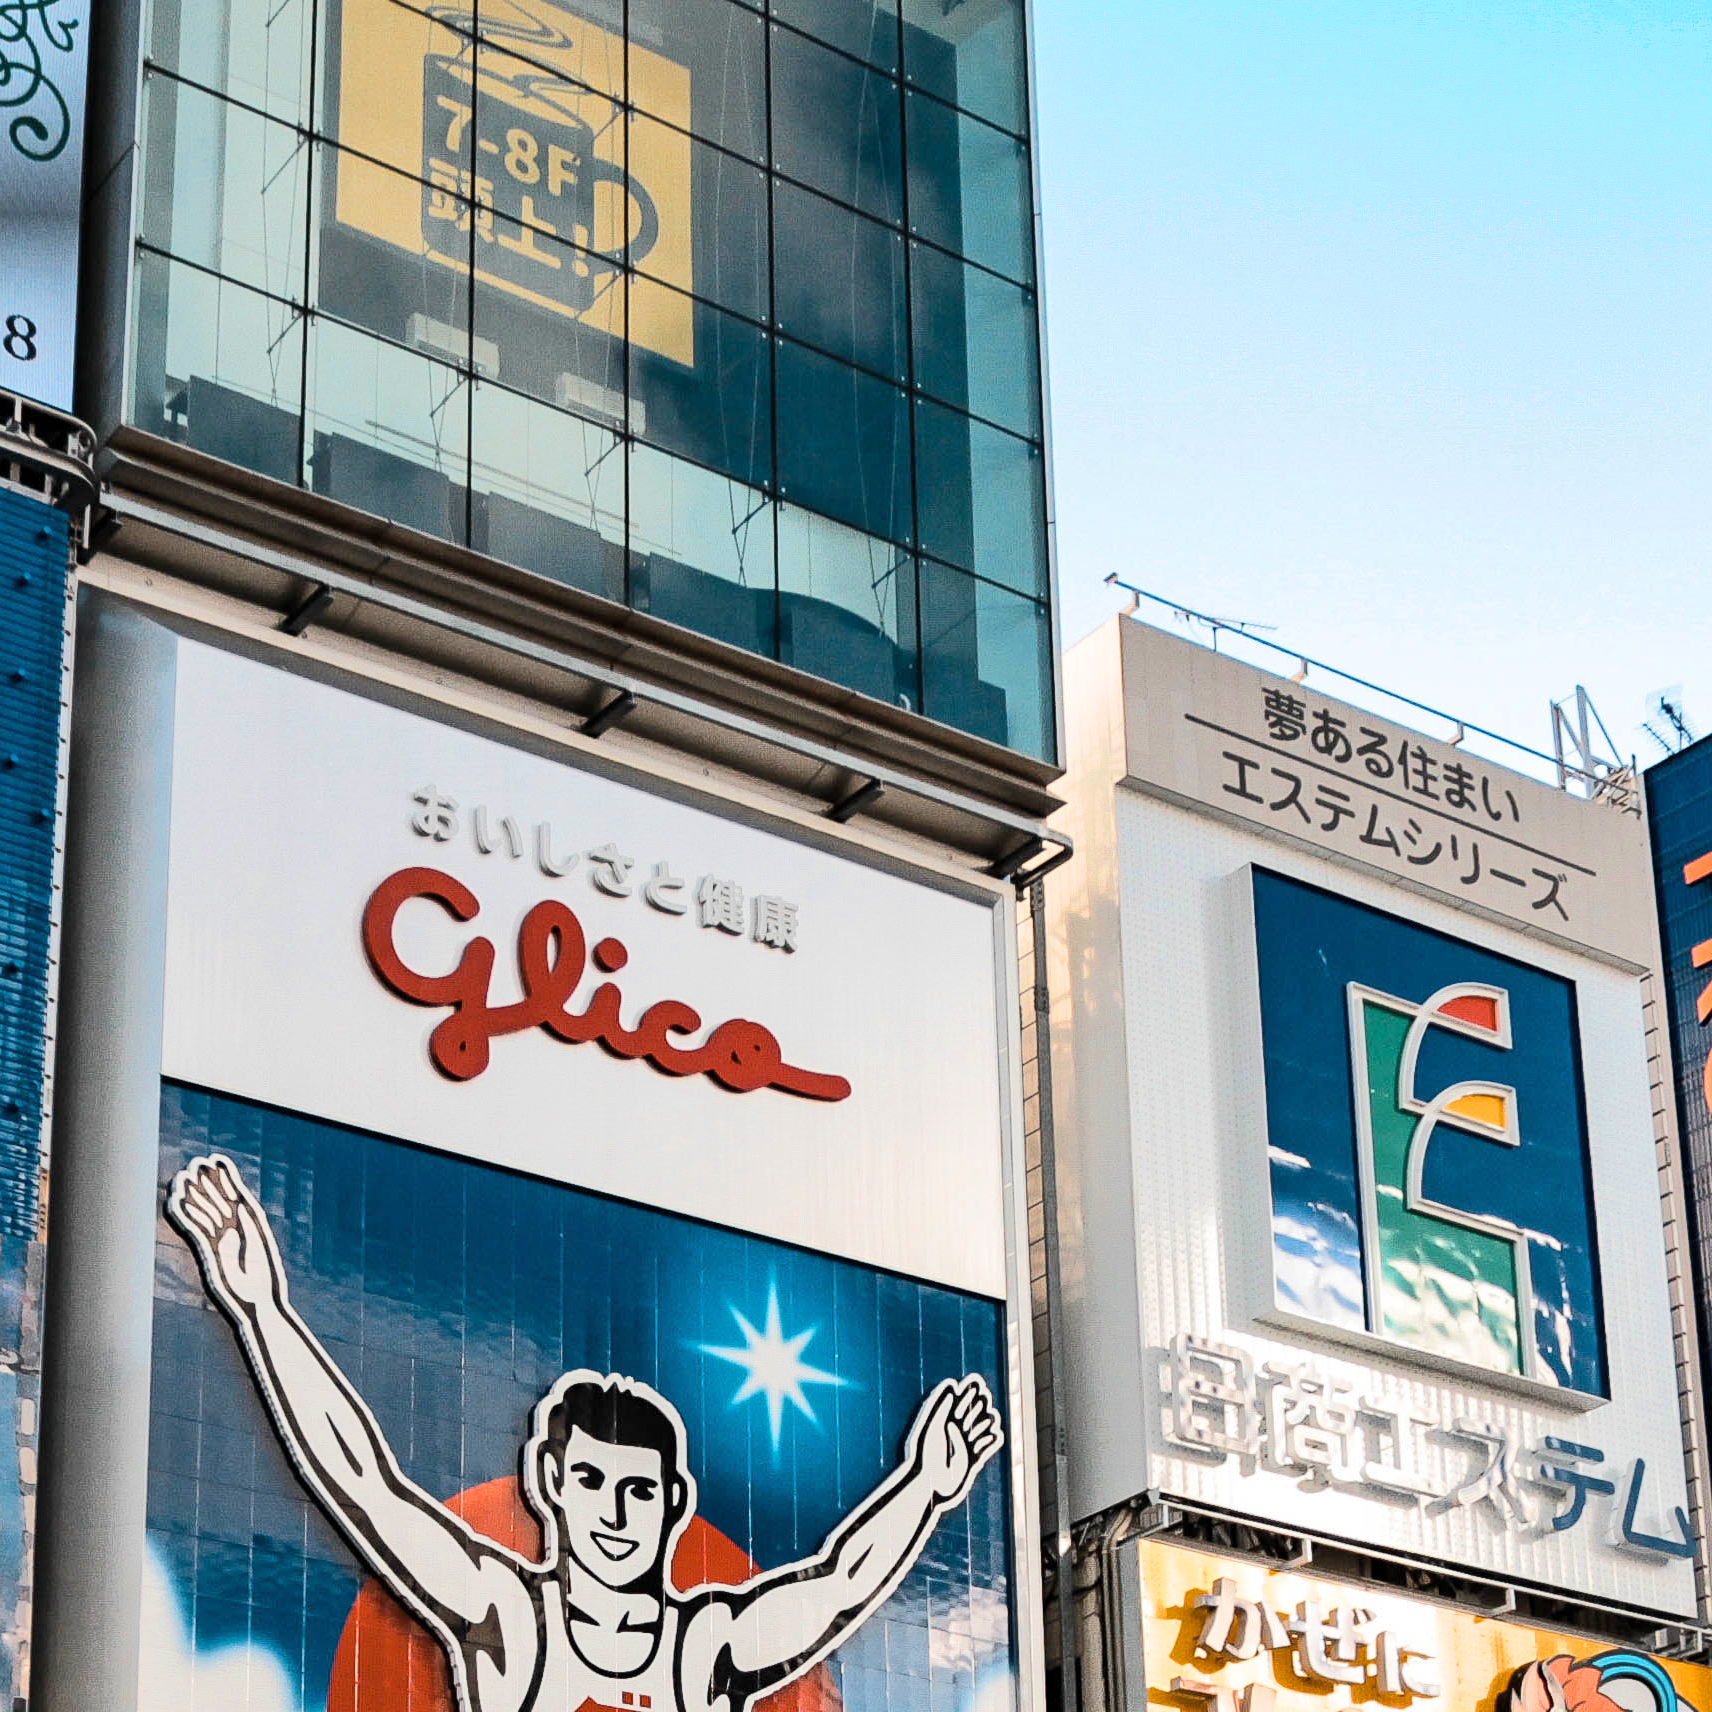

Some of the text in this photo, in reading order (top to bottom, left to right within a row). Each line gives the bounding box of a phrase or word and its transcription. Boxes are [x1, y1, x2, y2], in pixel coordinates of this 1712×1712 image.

[427, 156, 590, 278] 頭上!
[435, 94, 580, 198] 7-8F
[1261, 686, 1520, 823] 夢ある住まい
[410, 784, 800, 954] おいしさと健康
[1221, 750, 1569, 923] エステムシリーズ
[361, 866, 853, 1104] Glico
[1160, 1334, 1697, 1560] 日商エステム
[1191, 1576, 1441, 1698] かぜに
